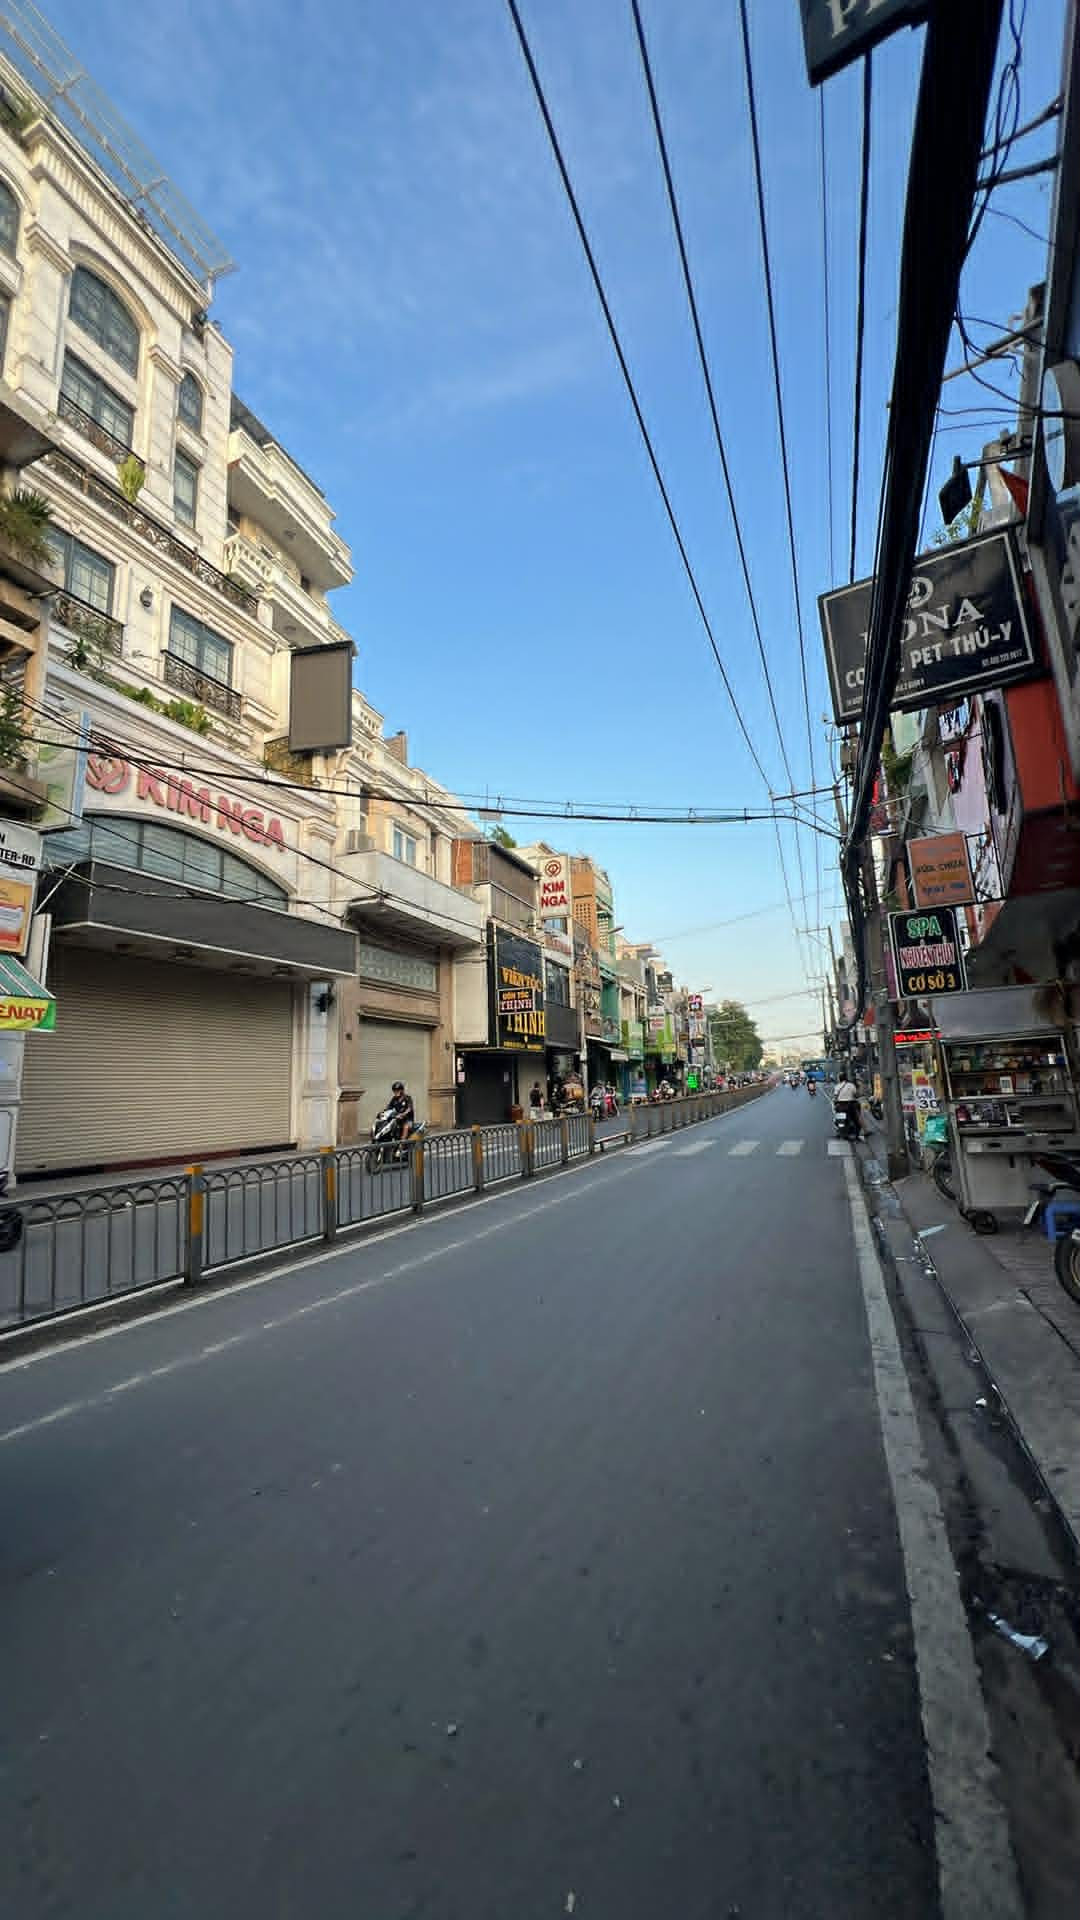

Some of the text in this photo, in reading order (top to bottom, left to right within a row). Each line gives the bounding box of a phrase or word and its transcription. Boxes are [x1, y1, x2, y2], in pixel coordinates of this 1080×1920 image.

[910, 642, 943, 669] PET
[136, 767, 286, 853] KIM NGA
[543, 880, 565, 894] KIM
[541, 894, 567, 909] NGA
[906, 915, 942, 939] SPA
